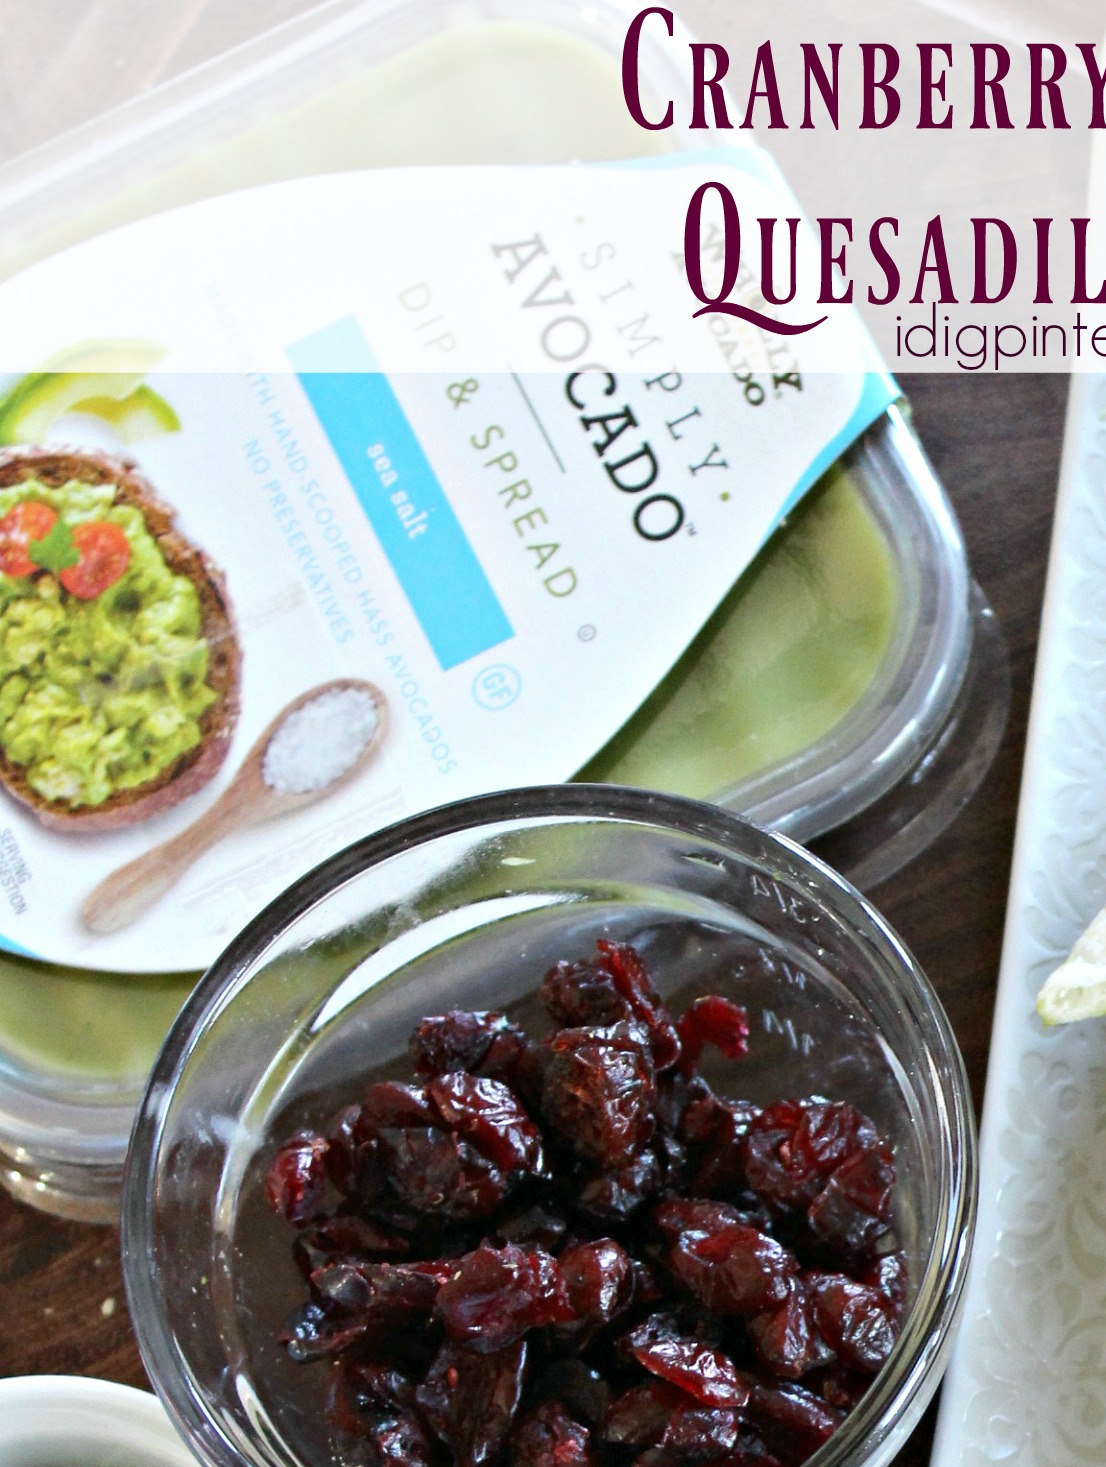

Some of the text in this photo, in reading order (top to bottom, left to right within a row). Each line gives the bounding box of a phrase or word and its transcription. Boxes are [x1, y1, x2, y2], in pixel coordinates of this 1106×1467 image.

[398, 281, 578, 598] DIP & SPREAD
[580, 242, 729, 477] SIMPLY
[243, 438, 355, 645] NO PRESERVATIVES
[366, 442, 433, 540] sea salt
[356, 590, 395, 647] HASS
[386, 652, 458, 775] AVOCADOS
